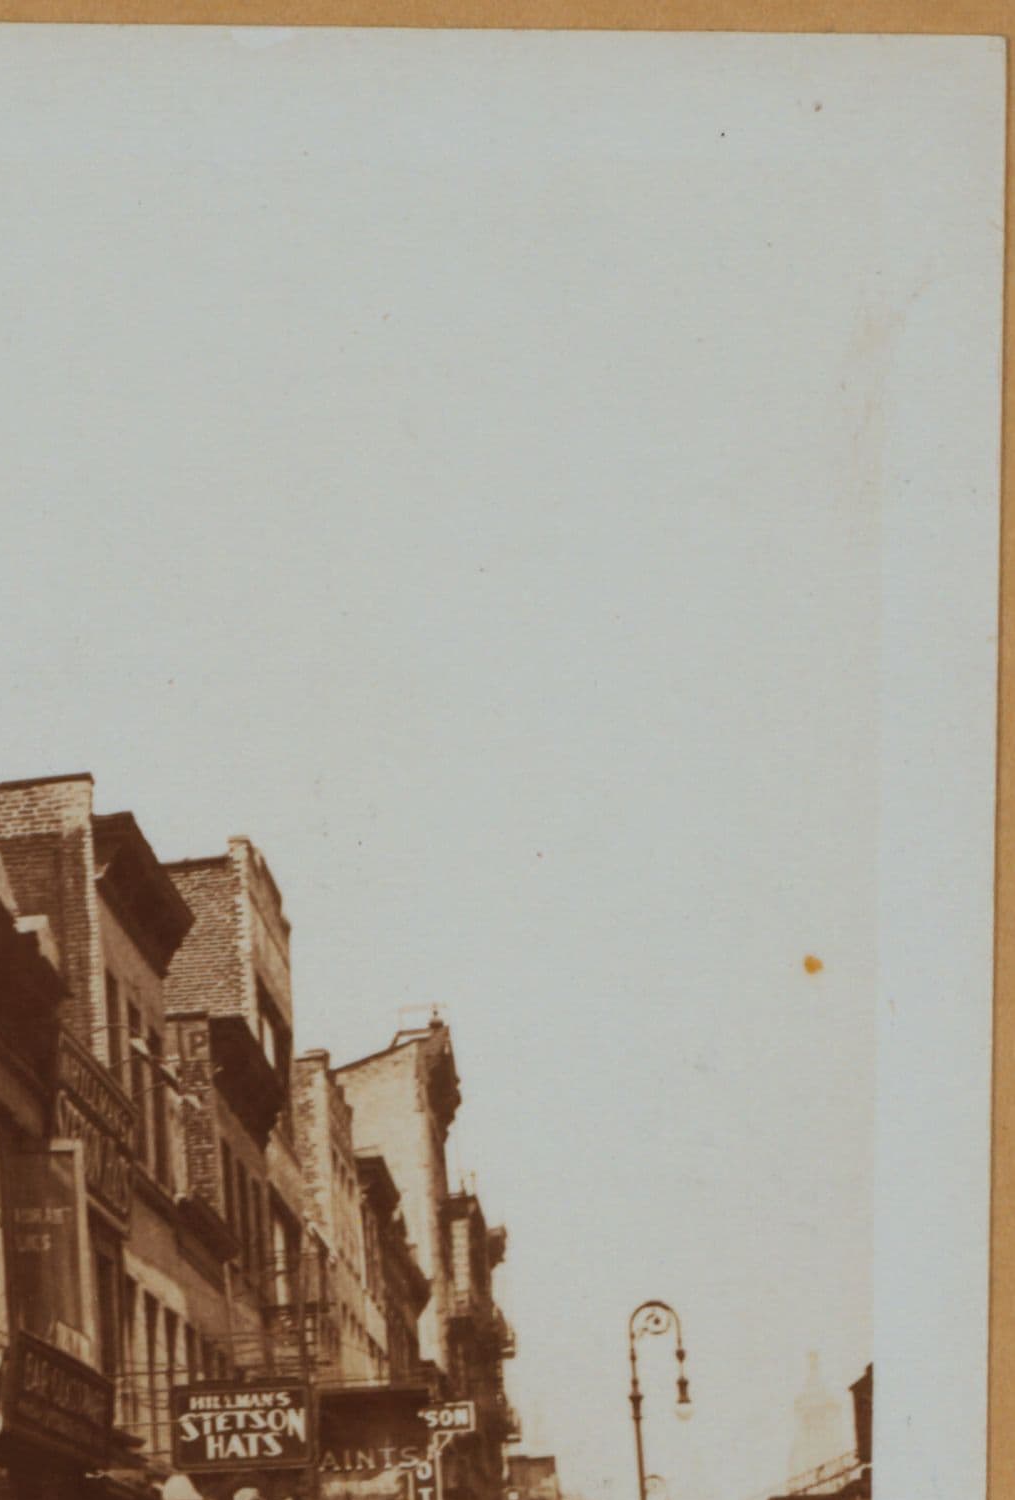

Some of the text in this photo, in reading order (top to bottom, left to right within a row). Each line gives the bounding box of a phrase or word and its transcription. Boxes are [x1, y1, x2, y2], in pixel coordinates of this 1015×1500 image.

[178, 1406, 307, 1443] STETSON
[206, 1432, 284, 1460] HATS
[317, 1446, 420, 1472] AINTS
